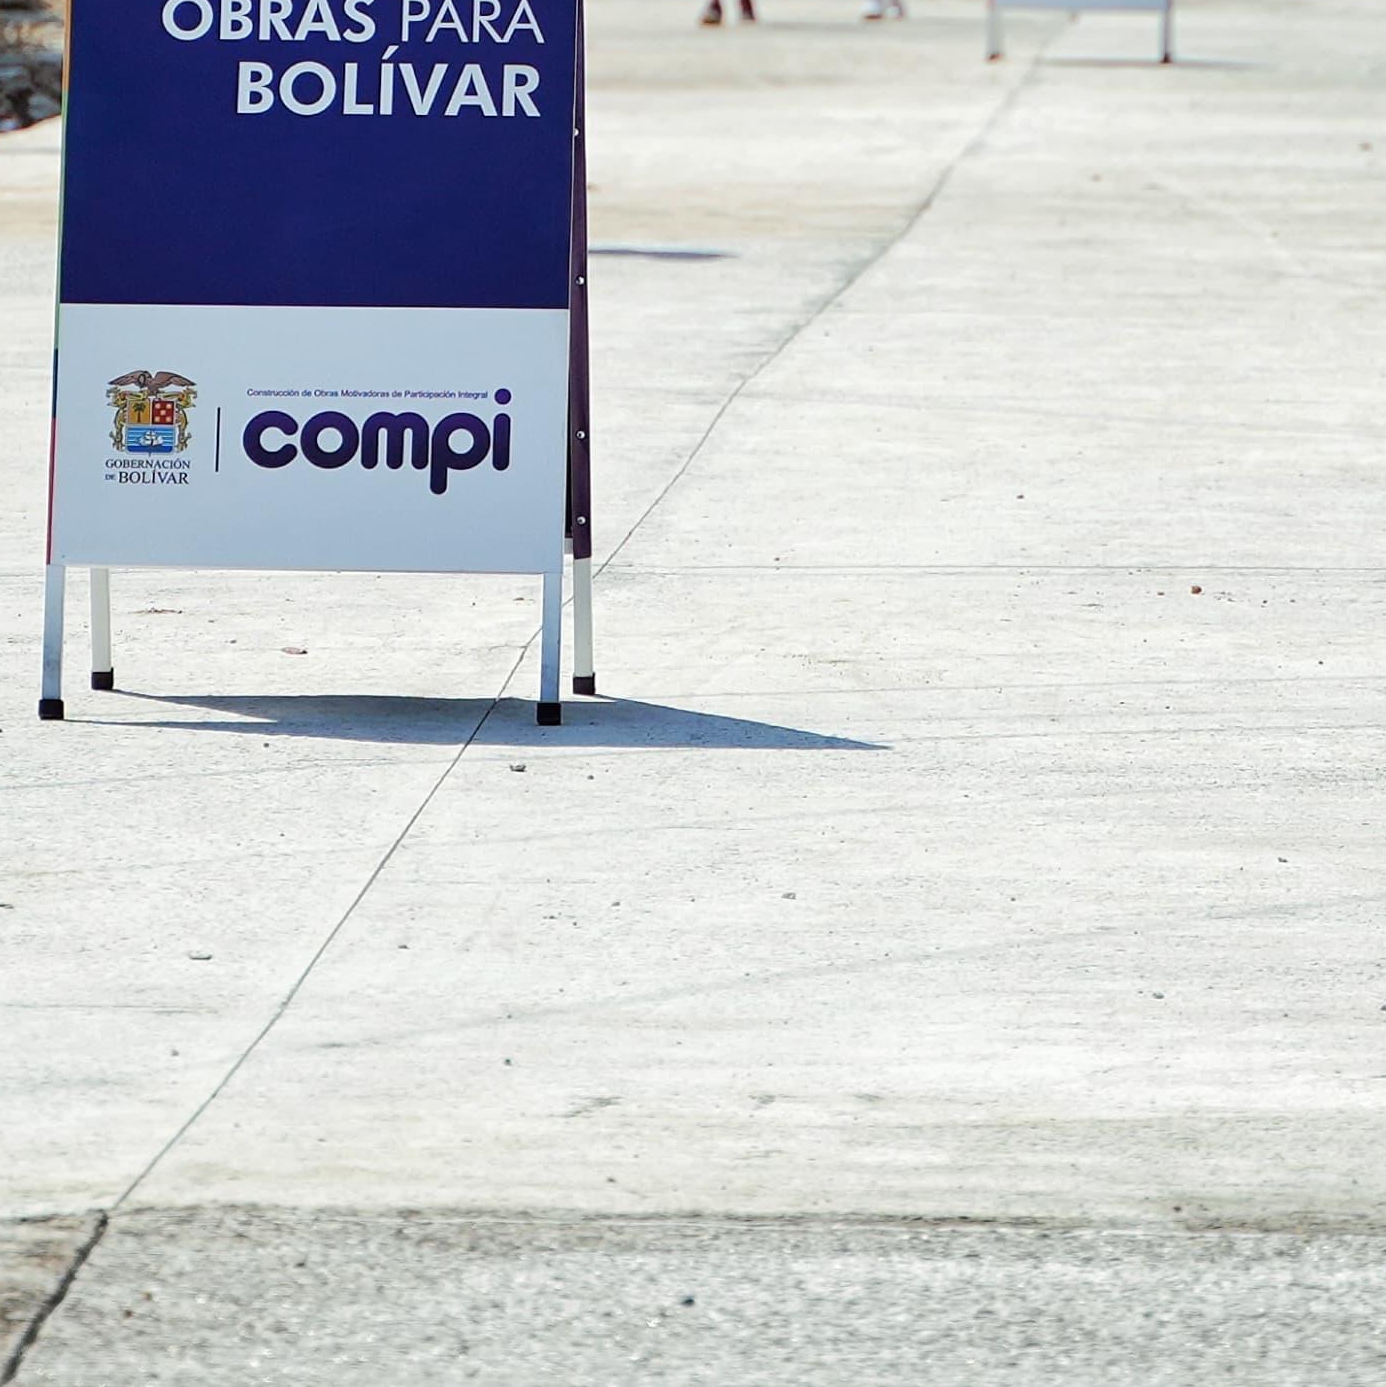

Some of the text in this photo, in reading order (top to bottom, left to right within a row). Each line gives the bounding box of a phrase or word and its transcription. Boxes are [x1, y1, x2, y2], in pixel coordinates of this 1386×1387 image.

[236, 45, 542, 117] BOLÍVAR
[246, 388, 489, 400] Construcción de Obras Motivadoras de Participación Integral
[242, 387, 512, 495] compi
[105, 458, 191, 470] GOBERNACIÓN
[118, 469, 189, 485] BOLÍVAR
